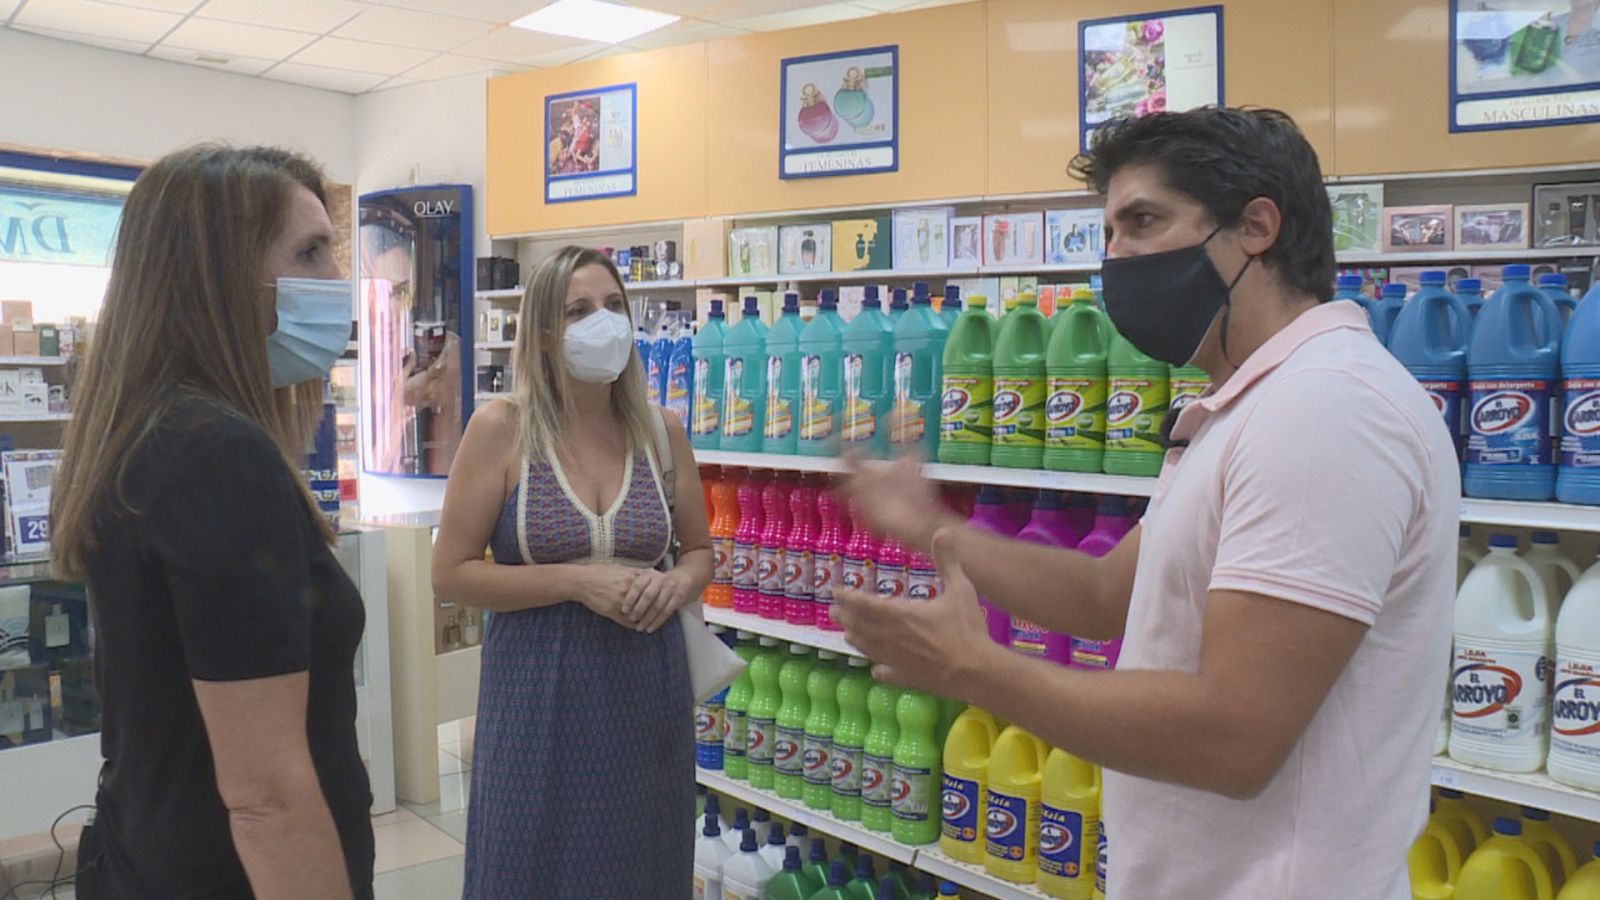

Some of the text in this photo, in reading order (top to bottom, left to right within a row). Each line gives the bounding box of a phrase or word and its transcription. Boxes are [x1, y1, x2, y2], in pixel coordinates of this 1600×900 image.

[1483, 103, 1599, 123] MASCULINAS
[414, 199, 454, 217] OLAY
[1470, 672, 1480, 683] EL
